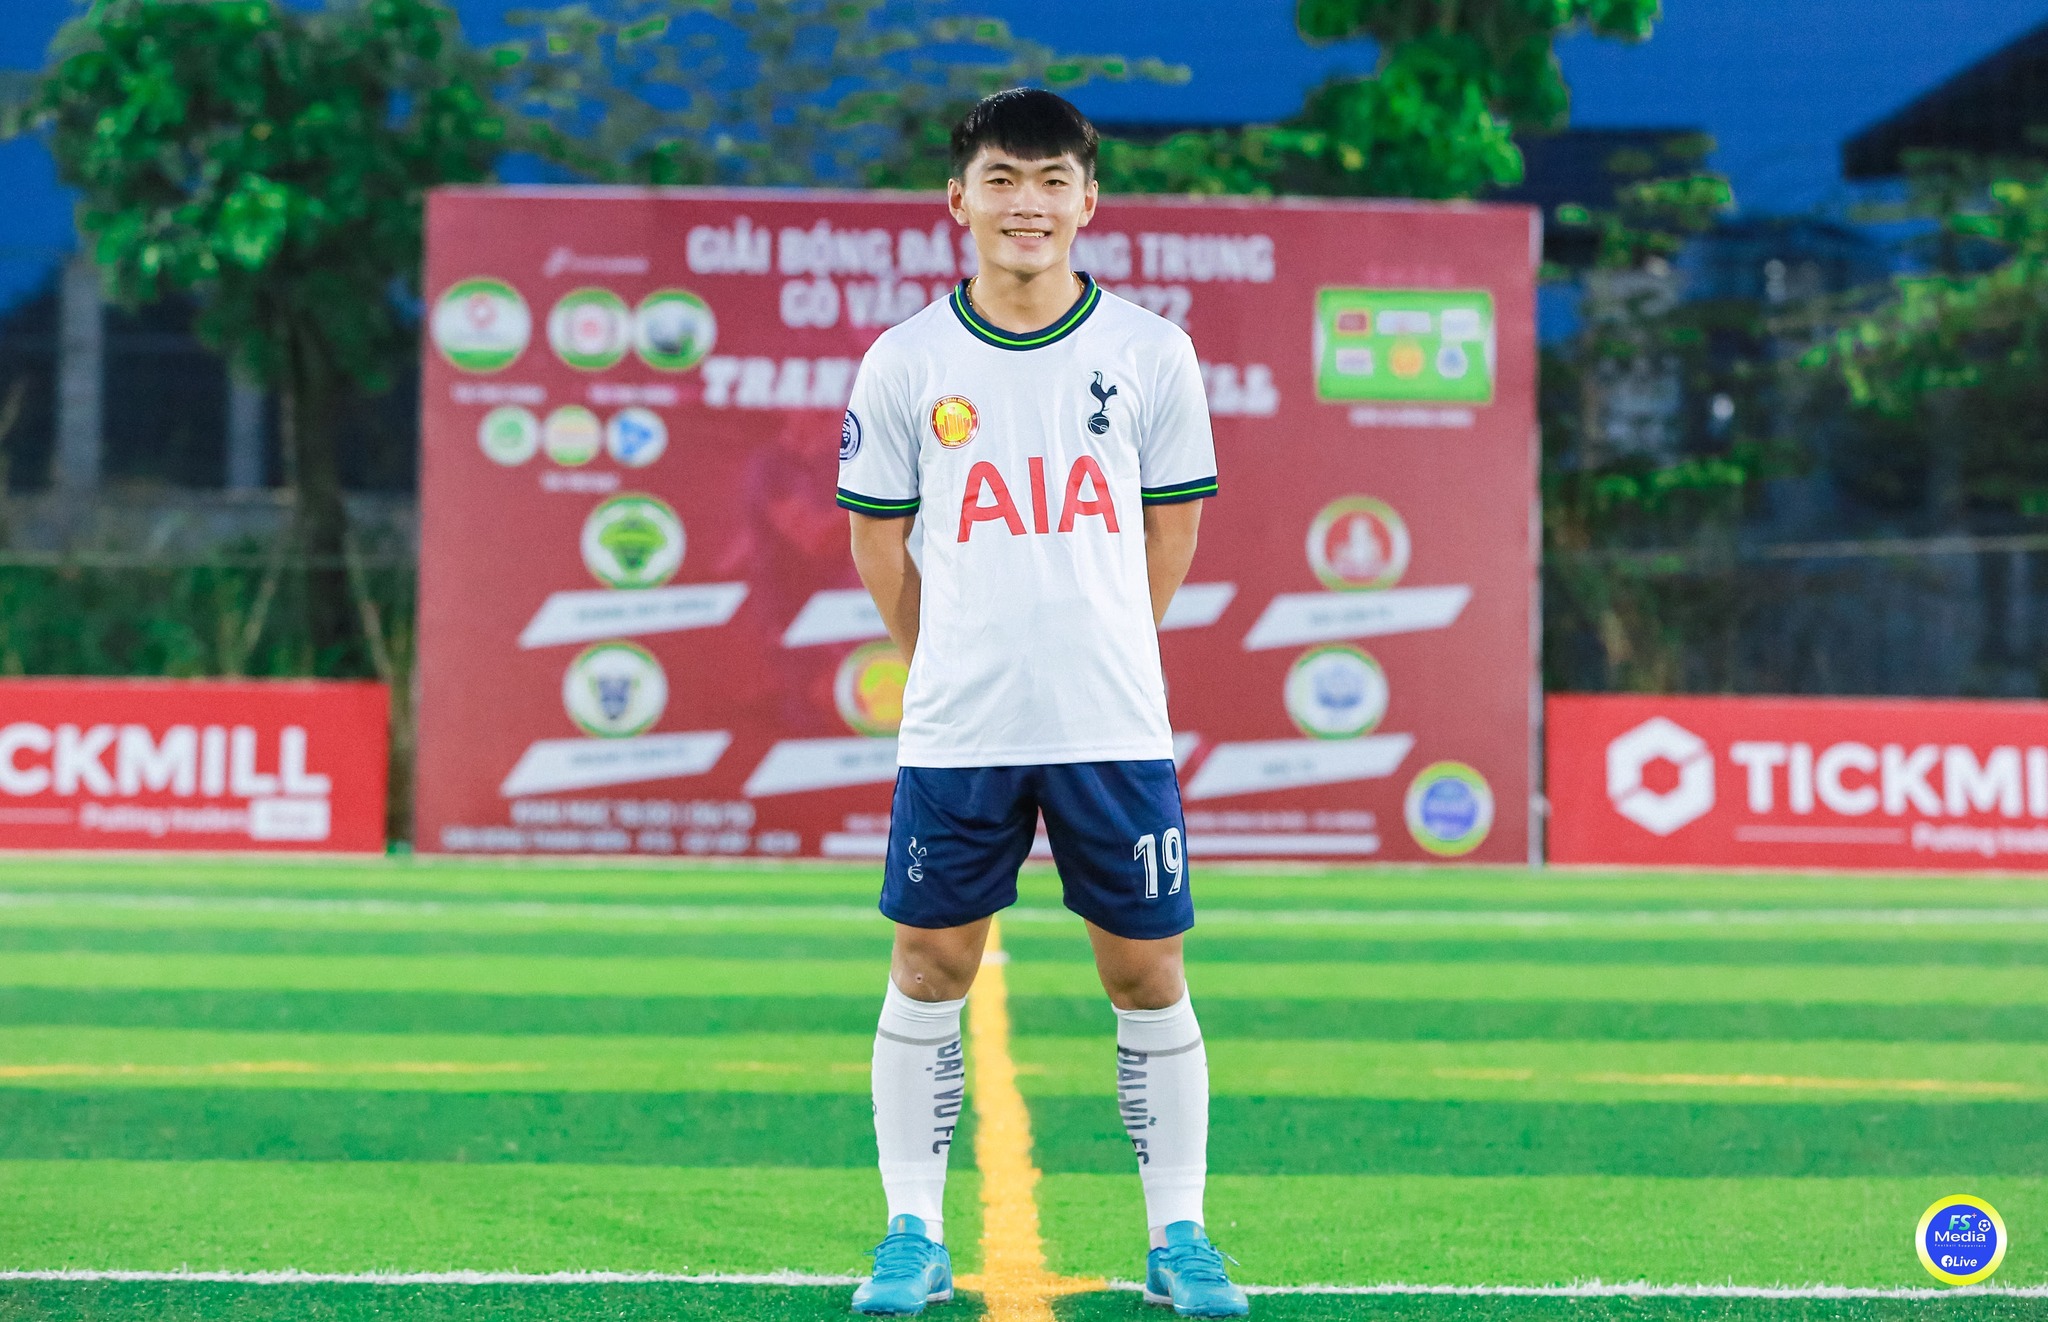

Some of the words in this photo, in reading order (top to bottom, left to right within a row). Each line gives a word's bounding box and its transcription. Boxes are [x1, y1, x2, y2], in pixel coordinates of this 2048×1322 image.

[1138, 231, 1275, 282] TRUNG
[957, 455, 1120, 543] AIA
[1133, 827, 1183, 899] 19
